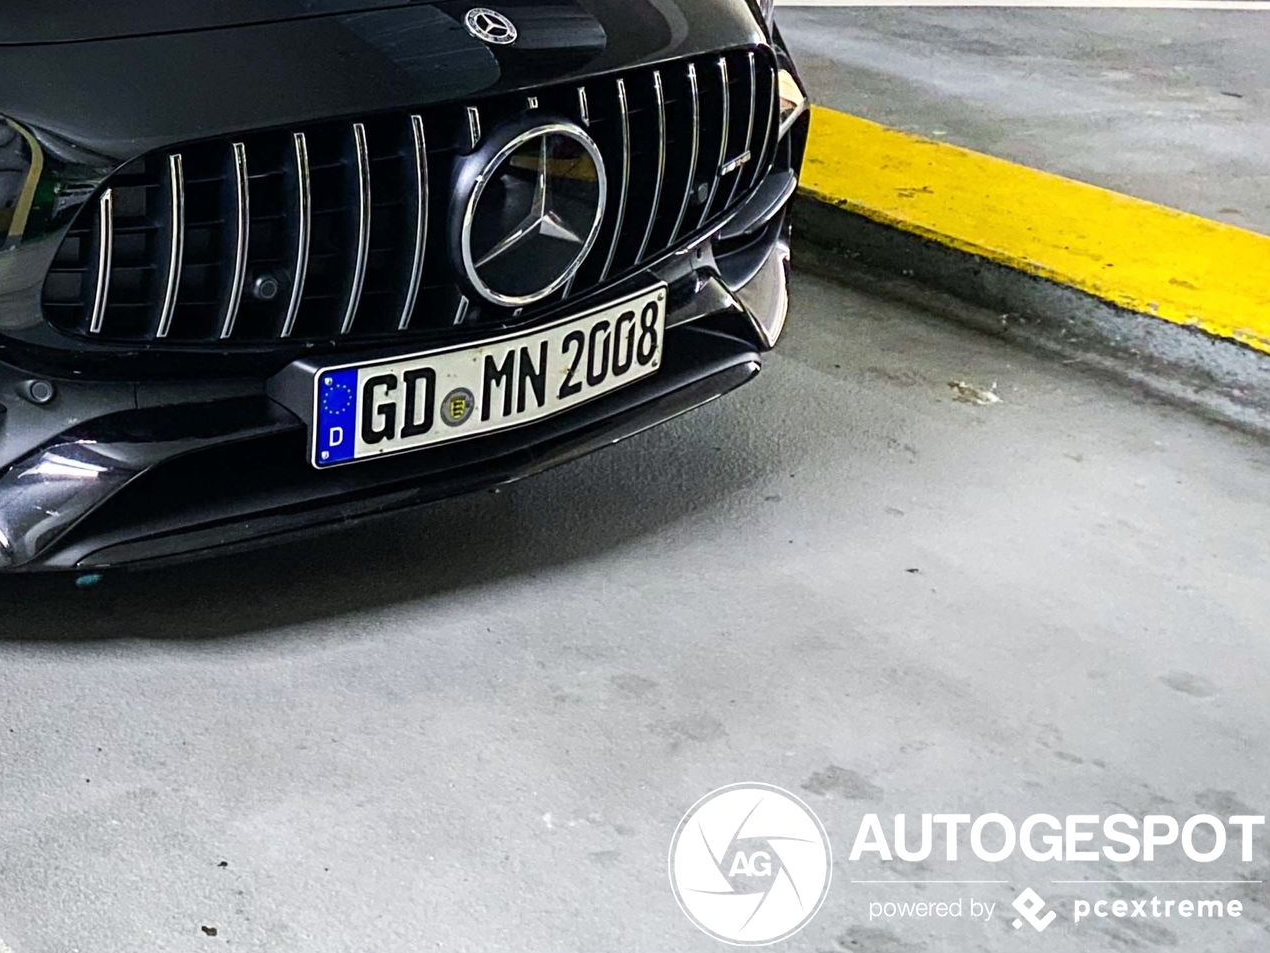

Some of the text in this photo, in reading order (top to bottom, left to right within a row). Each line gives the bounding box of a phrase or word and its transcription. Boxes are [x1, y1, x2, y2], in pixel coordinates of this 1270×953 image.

[361, 300, 659, 445] GD MN 2008
[329, 426, 344, 447] D
